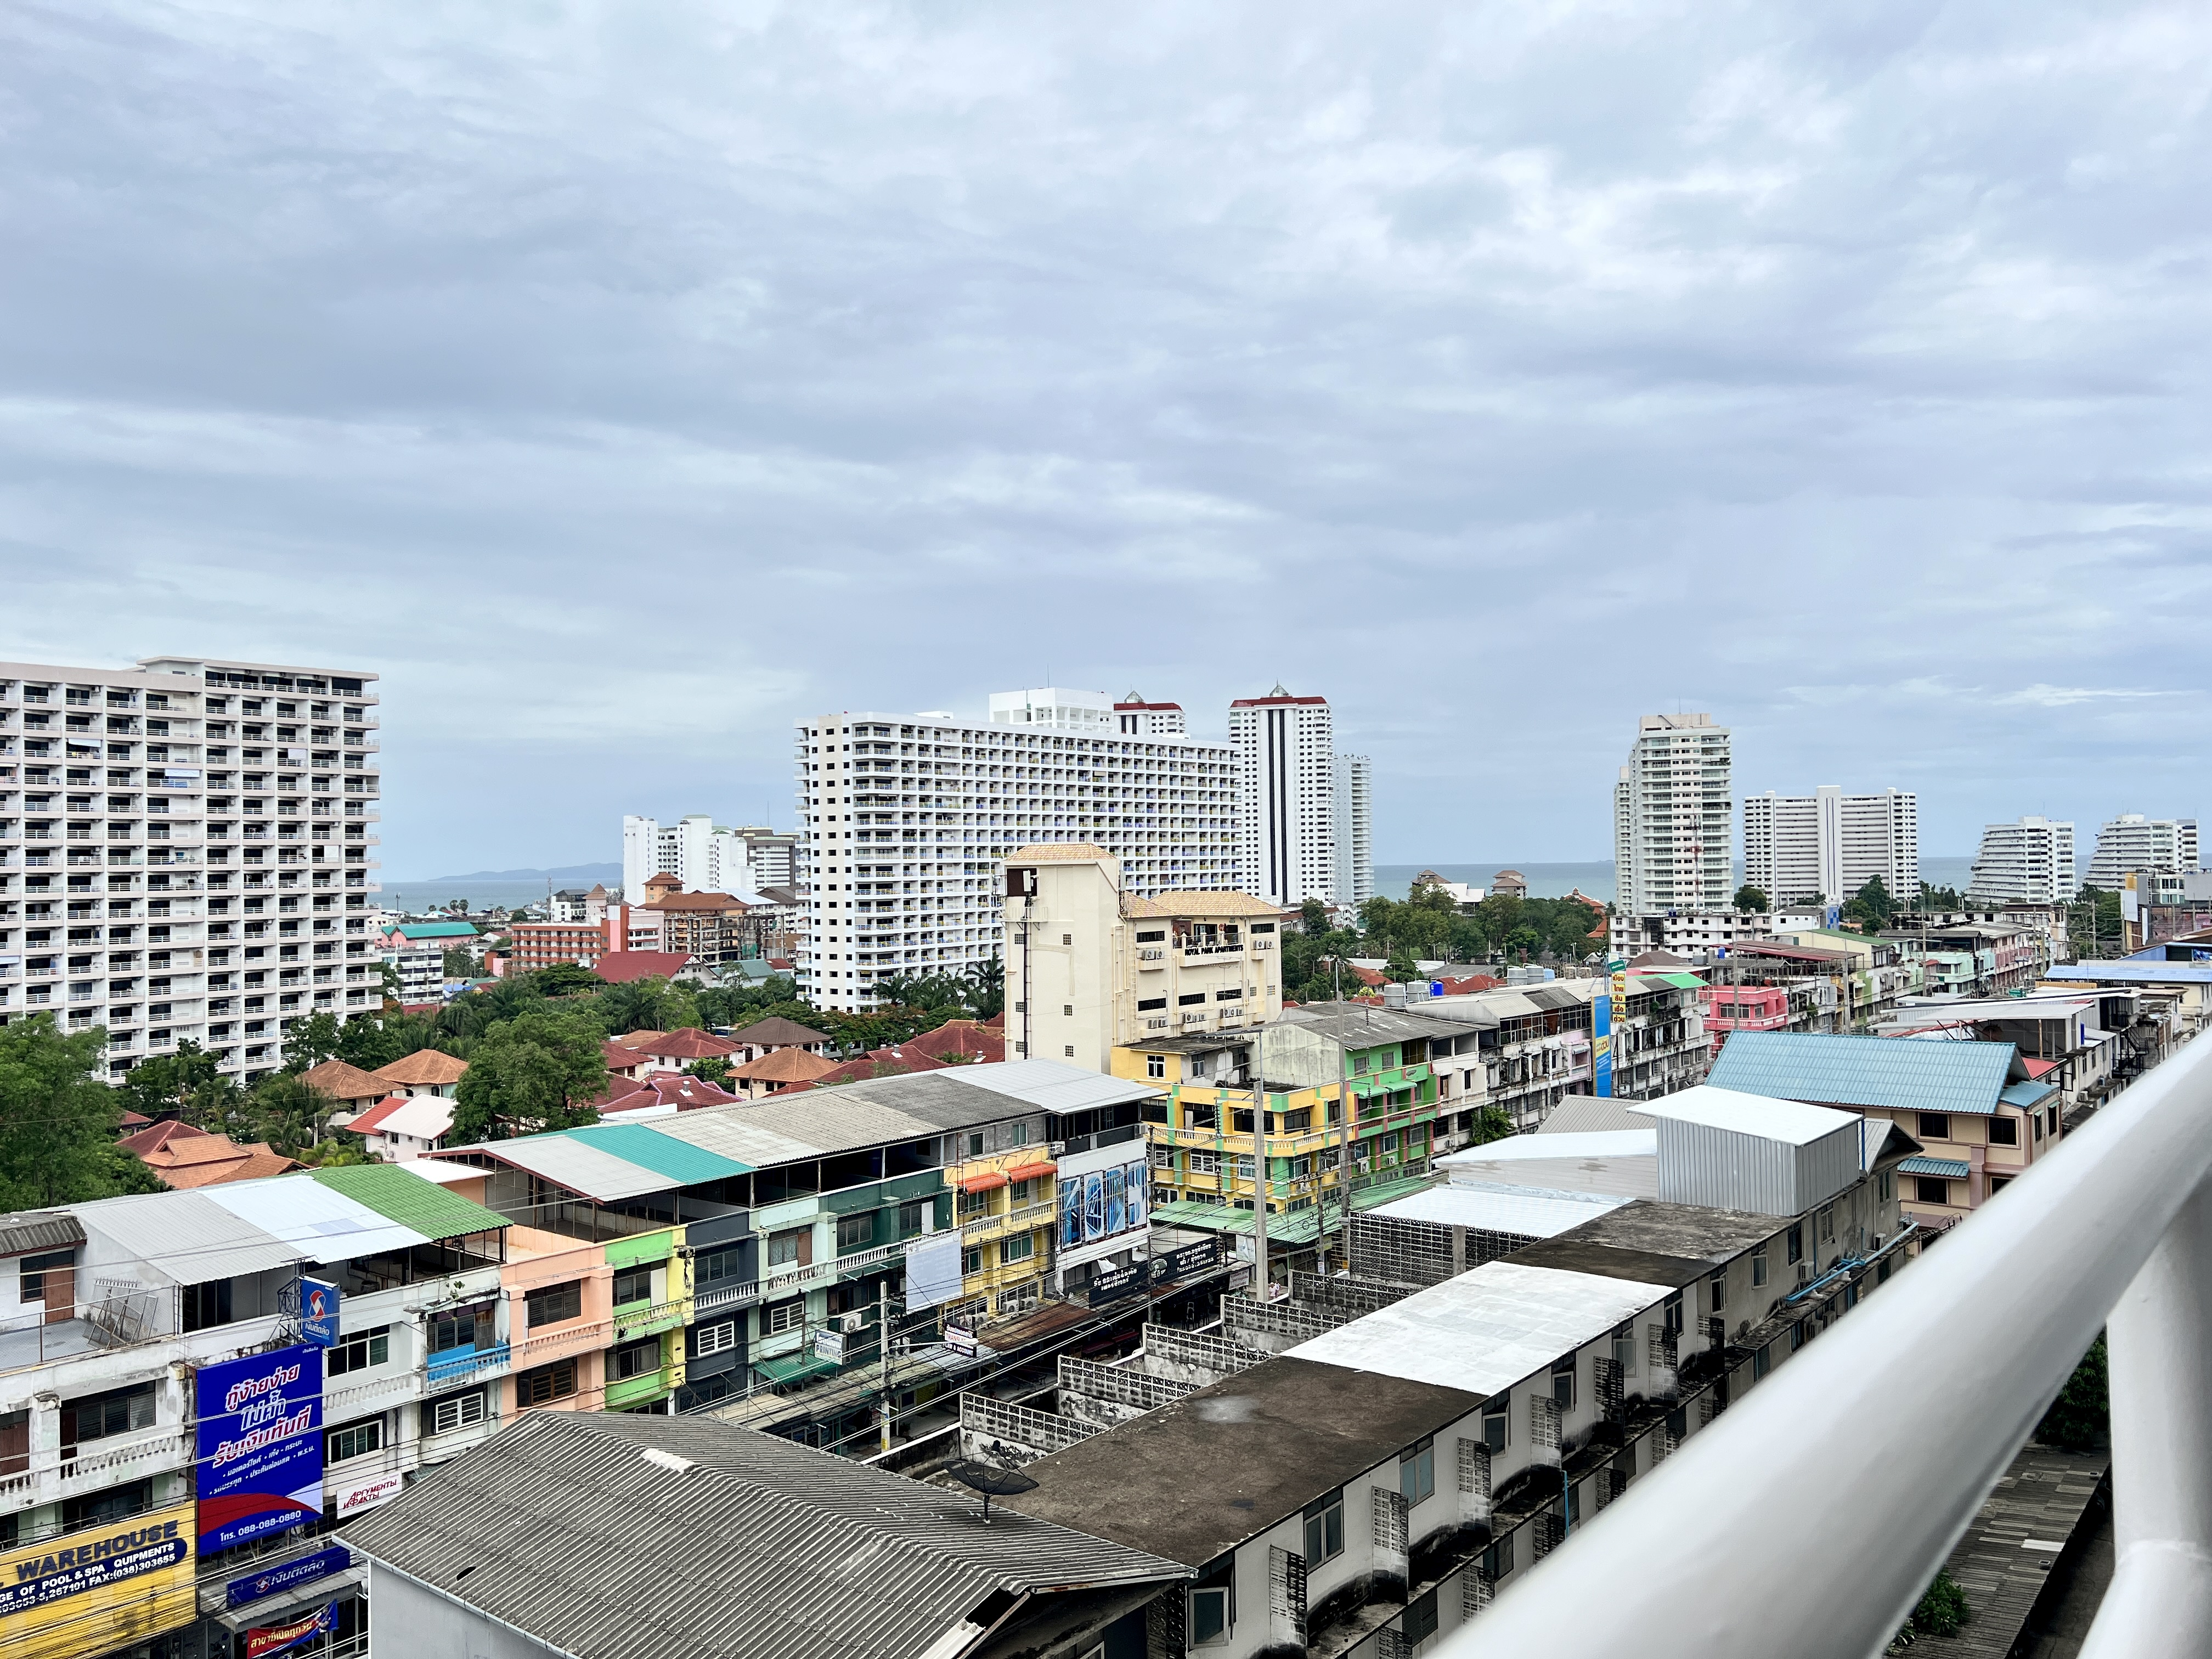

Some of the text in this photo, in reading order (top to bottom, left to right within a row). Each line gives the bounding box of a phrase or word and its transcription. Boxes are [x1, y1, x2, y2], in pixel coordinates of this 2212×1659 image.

[305, 1321, 330, 1336] เงินติดล้อ
[816, 1344, 842, 1358] PRINTING
[212, 1404, 312, 1469] รับเงินทันที
[285, 1440, 302, 1452] กระบะ
[349, 1479, 397, 1500] АРГУМЕНТЫ
[220, 1531, 236, 1542] โทร.
[238, 1510, 301, 1536] 088-088-0880
[16, 1520, 178, 1581] WAREHOUSE
[20, 1584, 36, 1596] OF
[42, 1575, 72, 1590] POOL
[75, 1571, 83, 1580] &
[84, 1564, 105, 1577] SPA
[114, 1542, 175, 1568] QUIPMENTS
[271, 1560, 325, 1585] เงินติดล้อ
[251, 1621, 313, 1648] สาขานี้เปิดทุกวัน
